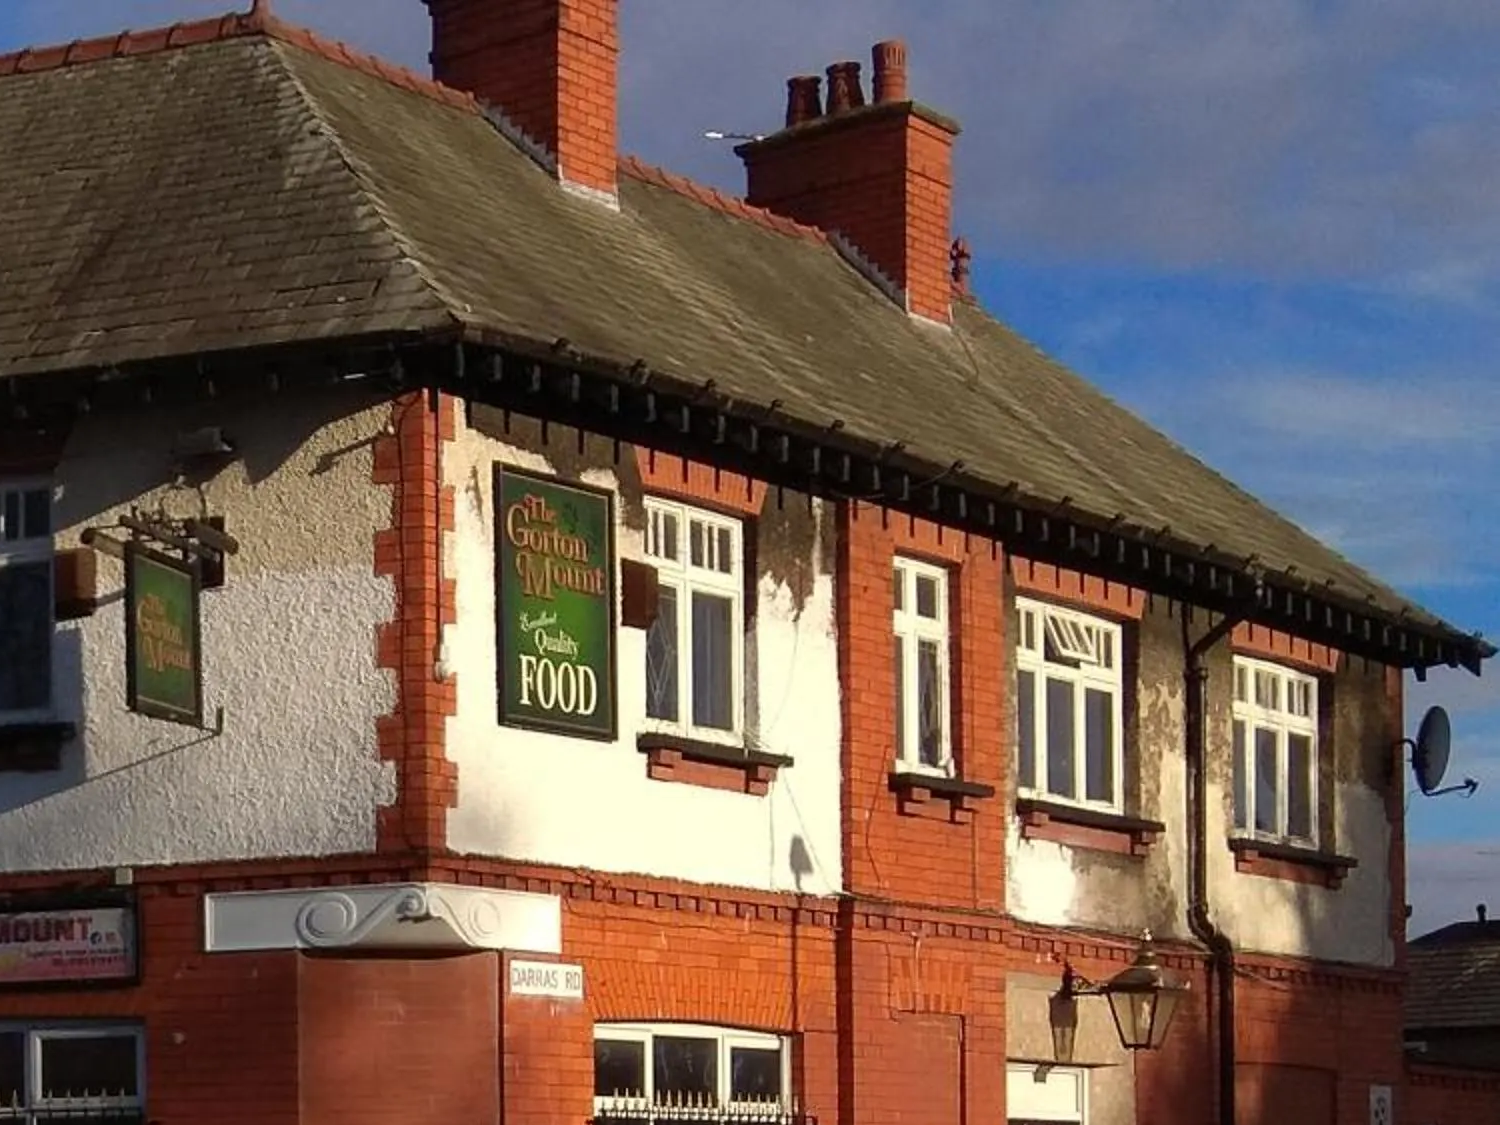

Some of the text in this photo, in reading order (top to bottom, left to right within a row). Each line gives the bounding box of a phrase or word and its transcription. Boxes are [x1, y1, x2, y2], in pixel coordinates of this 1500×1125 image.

[524, 494, 556, 521] The
[507, 504, 588, 562] Gorton
[515, 551, 606, 599] Mount
[519, 653, 597, 715] FOOD
[512, 967, 581, 990] DARRAS RD
